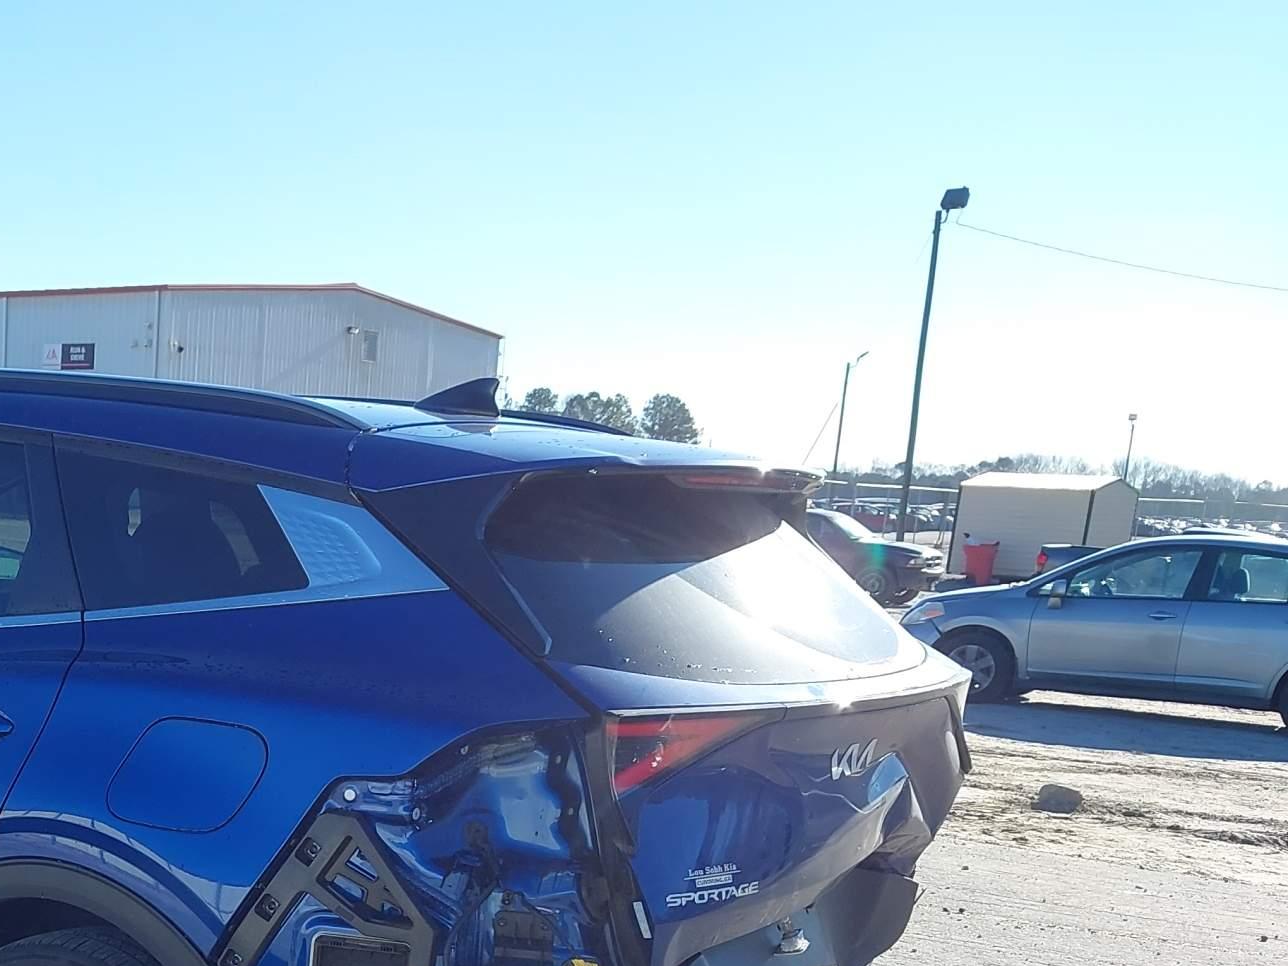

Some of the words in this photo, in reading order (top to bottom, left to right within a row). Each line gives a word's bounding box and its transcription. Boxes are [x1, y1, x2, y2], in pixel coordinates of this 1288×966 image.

[688, 869, 704, 877] Lou
[724, 862, 737, 872] Kia
[665, 881, 760, 907] SPORTAGE
